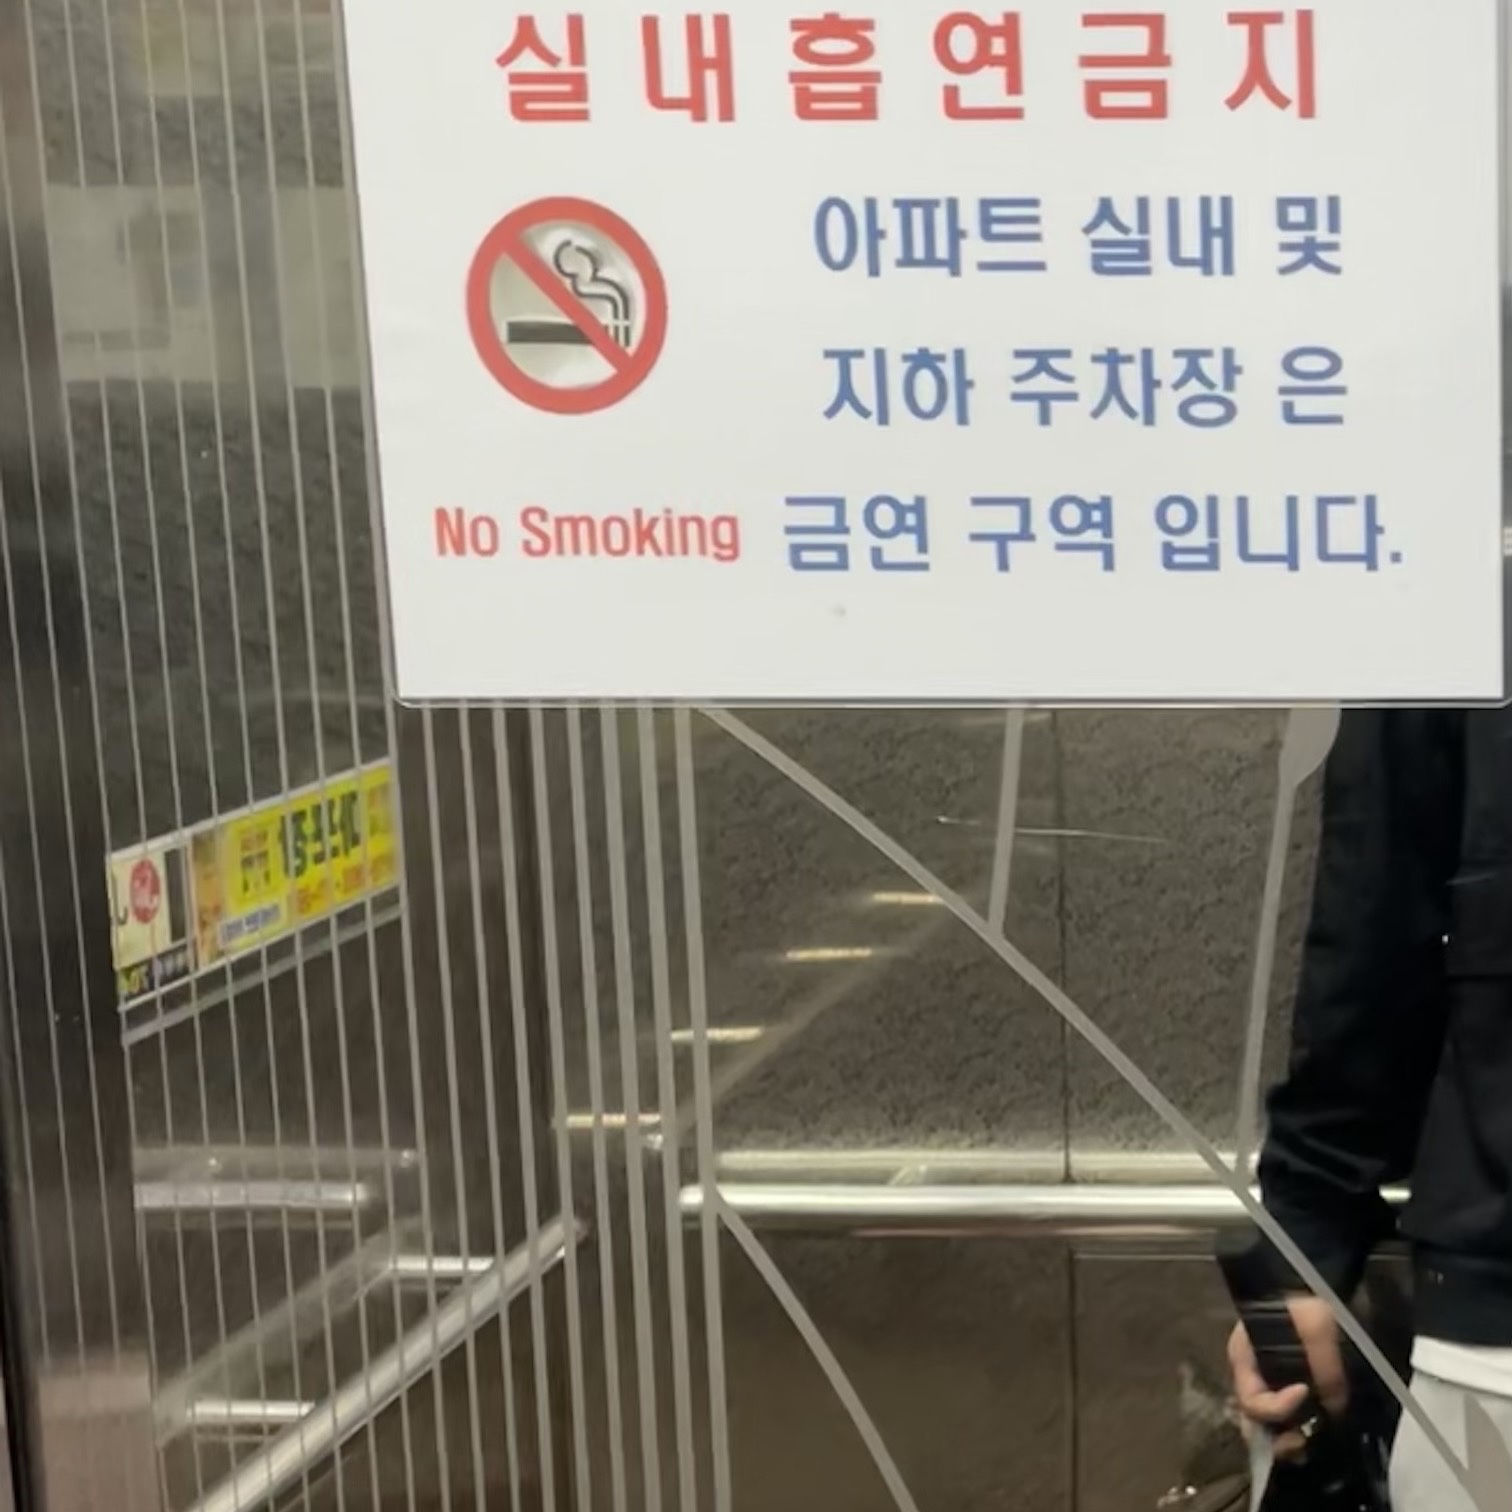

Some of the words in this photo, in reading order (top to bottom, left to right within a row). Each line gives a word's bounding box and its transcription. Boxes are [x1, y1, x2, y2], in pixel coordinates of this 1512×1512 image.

[496, 10, 1316, 122] 실내흡연금지
[814, 196, 1047, 278] 아파트
[1081, 195, 1235, 277] 실내
[1275, 195, 1342, 276] 및
[823, 347, 975, 426] 지하
[1010, 347, 1243, 428] 주차장
[1278, 346, 1348, 425] 은
[435, 507, 499, 557] No
[520, 506, 740, 562] Smoking
[784, 494, 930, 572] 금연
[968, 494, 1115, 573] 구역
[1154, 494, 1402, 572] 입니다.
